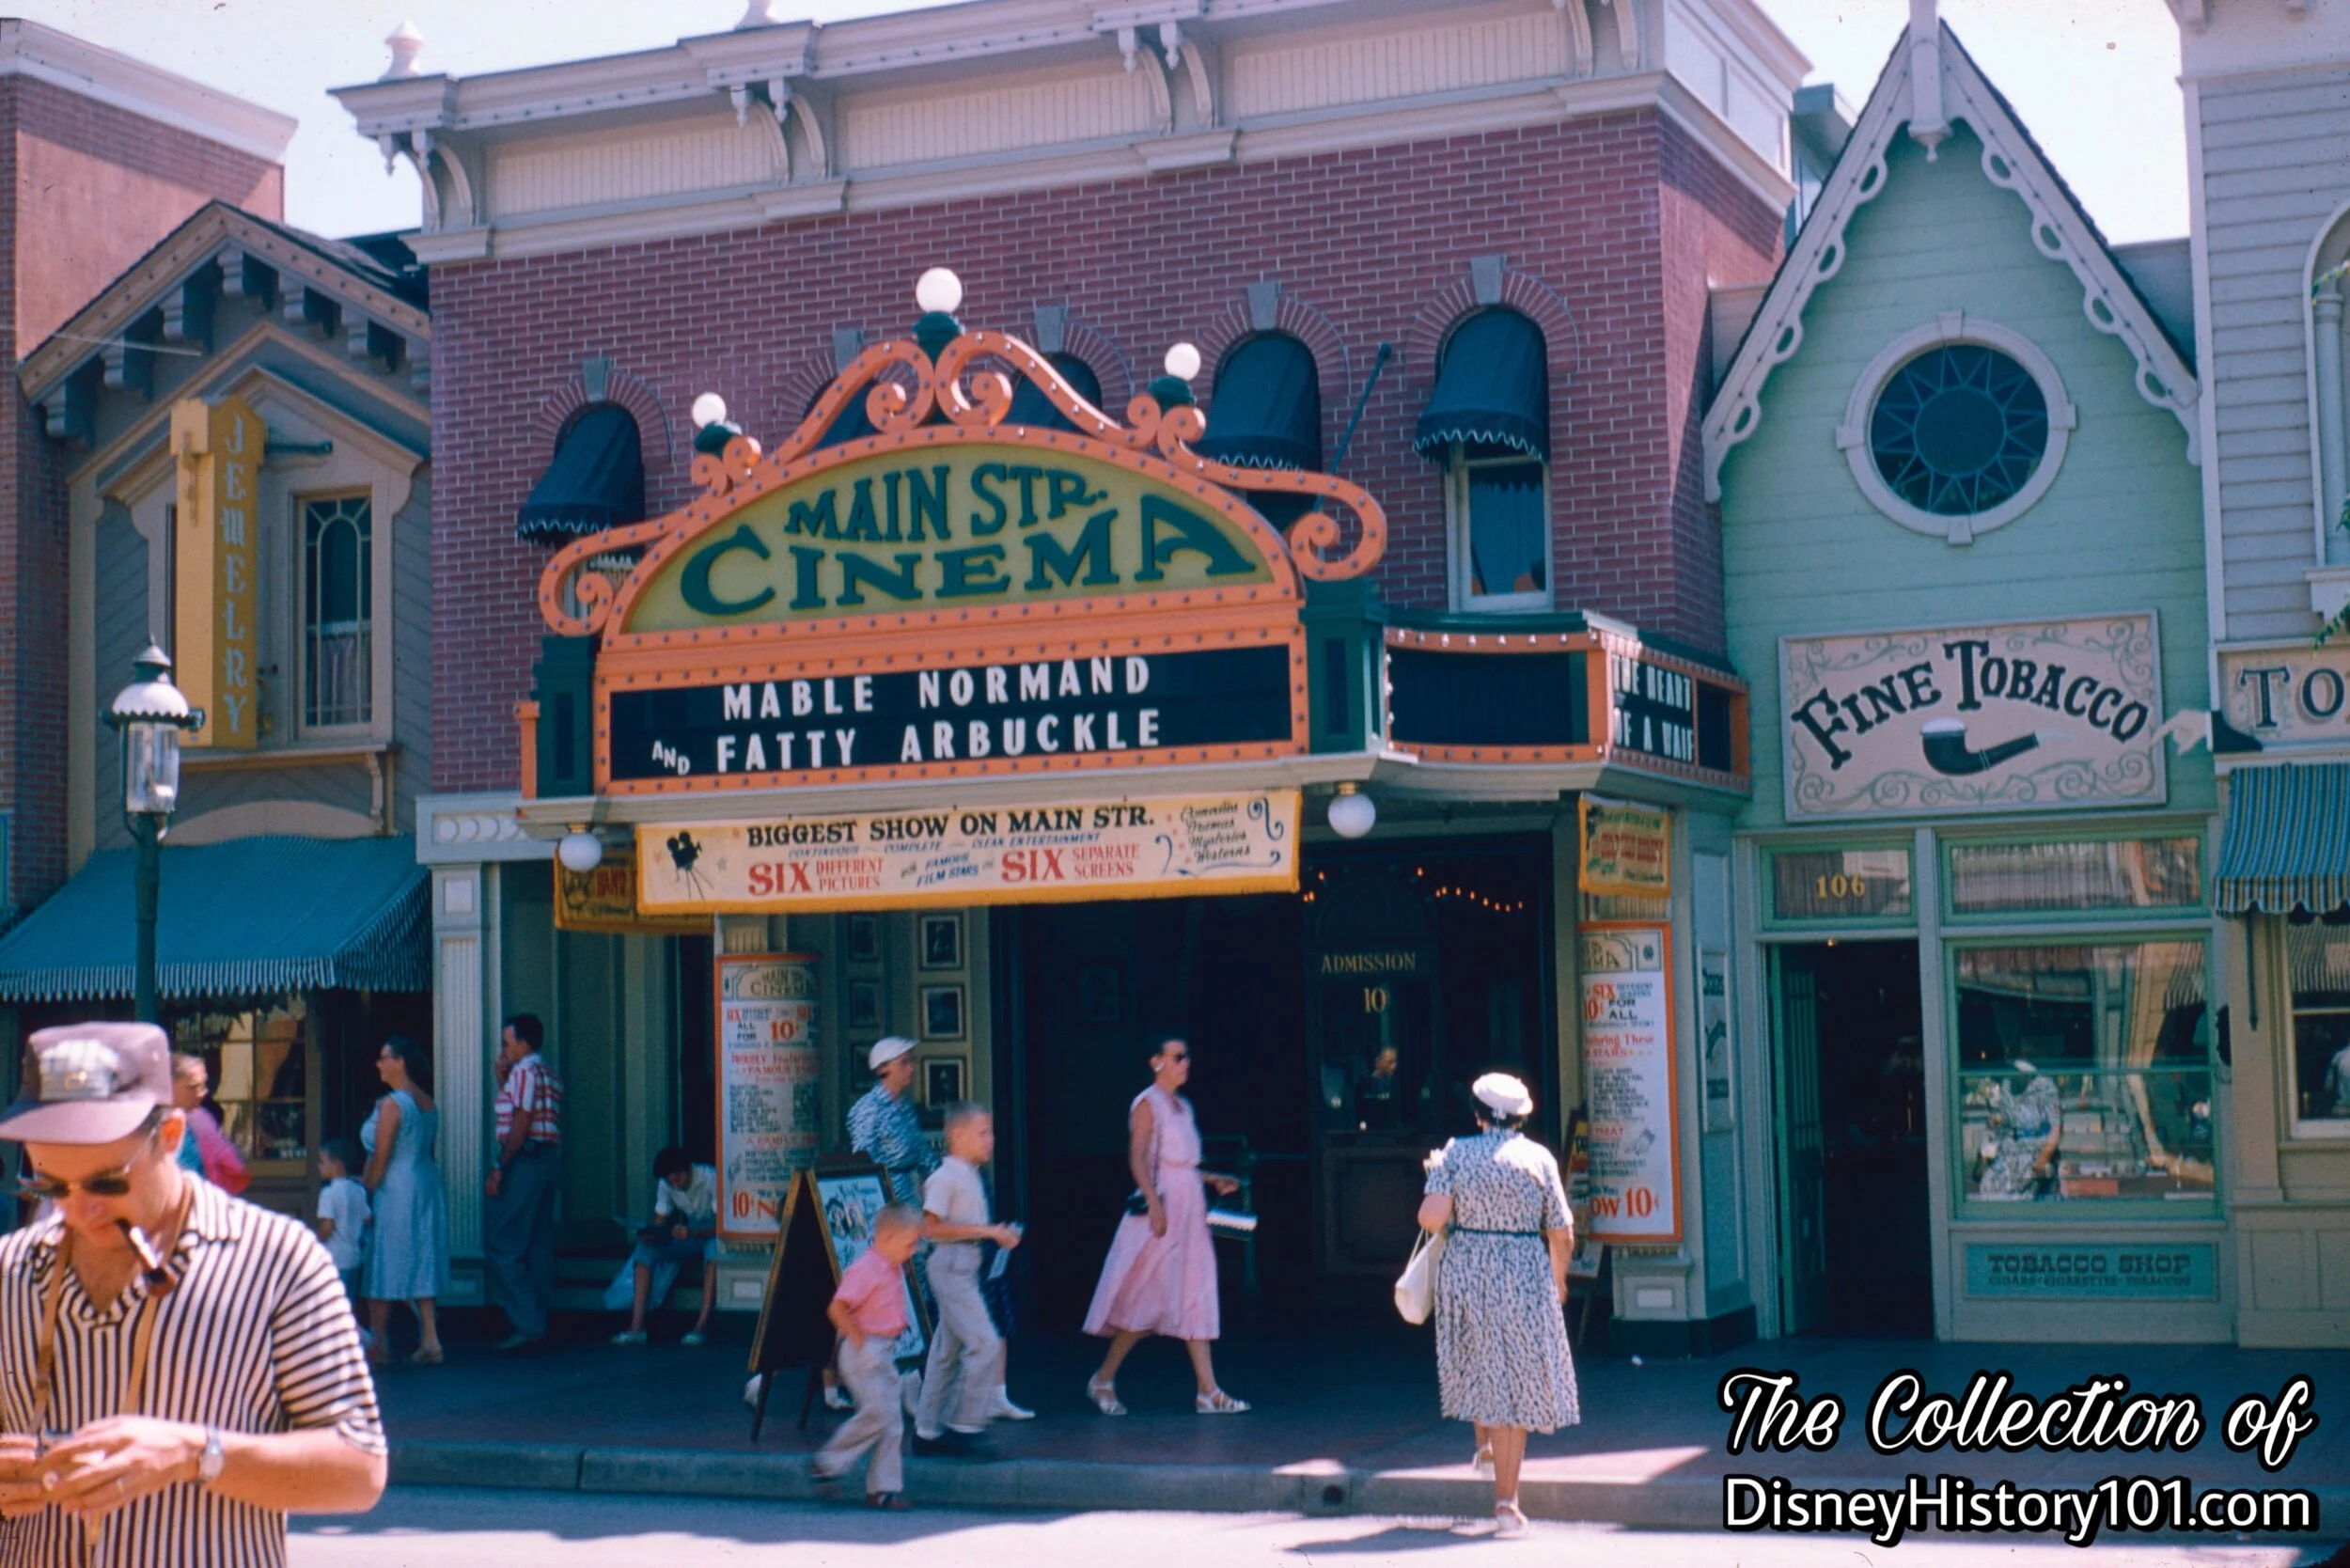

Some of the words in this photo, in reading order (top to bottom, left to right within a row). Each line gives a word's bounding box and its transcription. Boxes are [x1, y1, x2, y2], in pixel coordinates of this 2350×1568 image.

[785, 466, 951, 542] MAIN
[971, 463, 1108, 537] STR.
[681, 493, 1257, 615] CINEMA
[222, 415, 247, 733] JEWELRY
[724, 675, 872, 720] MABLE
[918, 656, 1149, 708] NORMAND
[1647, 666, 1691, 712] HEART
[1792, 662, 1941, 771] FINE
[1943, 640, 2149, 745] TOBACCO
[651, 741, 690, 776] AND
[717, 729, 855, 773] FATTY
[901, 710, 1159, 762] ARBUCKLE
[1643, 715, 1653, 752] A
[747, 822, 856, 847] BIGGEST
[870, 815, 948, 841] SHOW
[961, 811, 997, 836] ON
[1008, 808, 1082, 833] MAIN
[1093, 805, 1154, 829] STR.
[1010, 832, 1101, 848] ENTERTAINMENT
[1072, 843, 1140, 860] SEPARATE
[1188, 831, 1247, 849] Mysteries
[816, 857, 885, 874] DIFFERENT
[925, 852, 969, 870] FAMOUS
[1194, 845, 1251, 863] Westerns
[916, 870, 946, 887] FILM
[948, 864, 979, 879] STARS
[1001, 849, 1066, 883] SIX
[1074, 860, 1135, 880] SCREENS
[748, 861, 813, 897] SIX
[819, 874, 881, 892] PICTURES
[1816, 873, 1866, 900] 106
[1322, 952, 1417, 974] ADMISSION
[1608, 1010, 1638, 1020] ALL
[1590, 1196, 1621, 1218] OW
[1987, 1255, 2107, 1273] TOBACCO
[2119, 1255, 2191, 1273] SHOP
